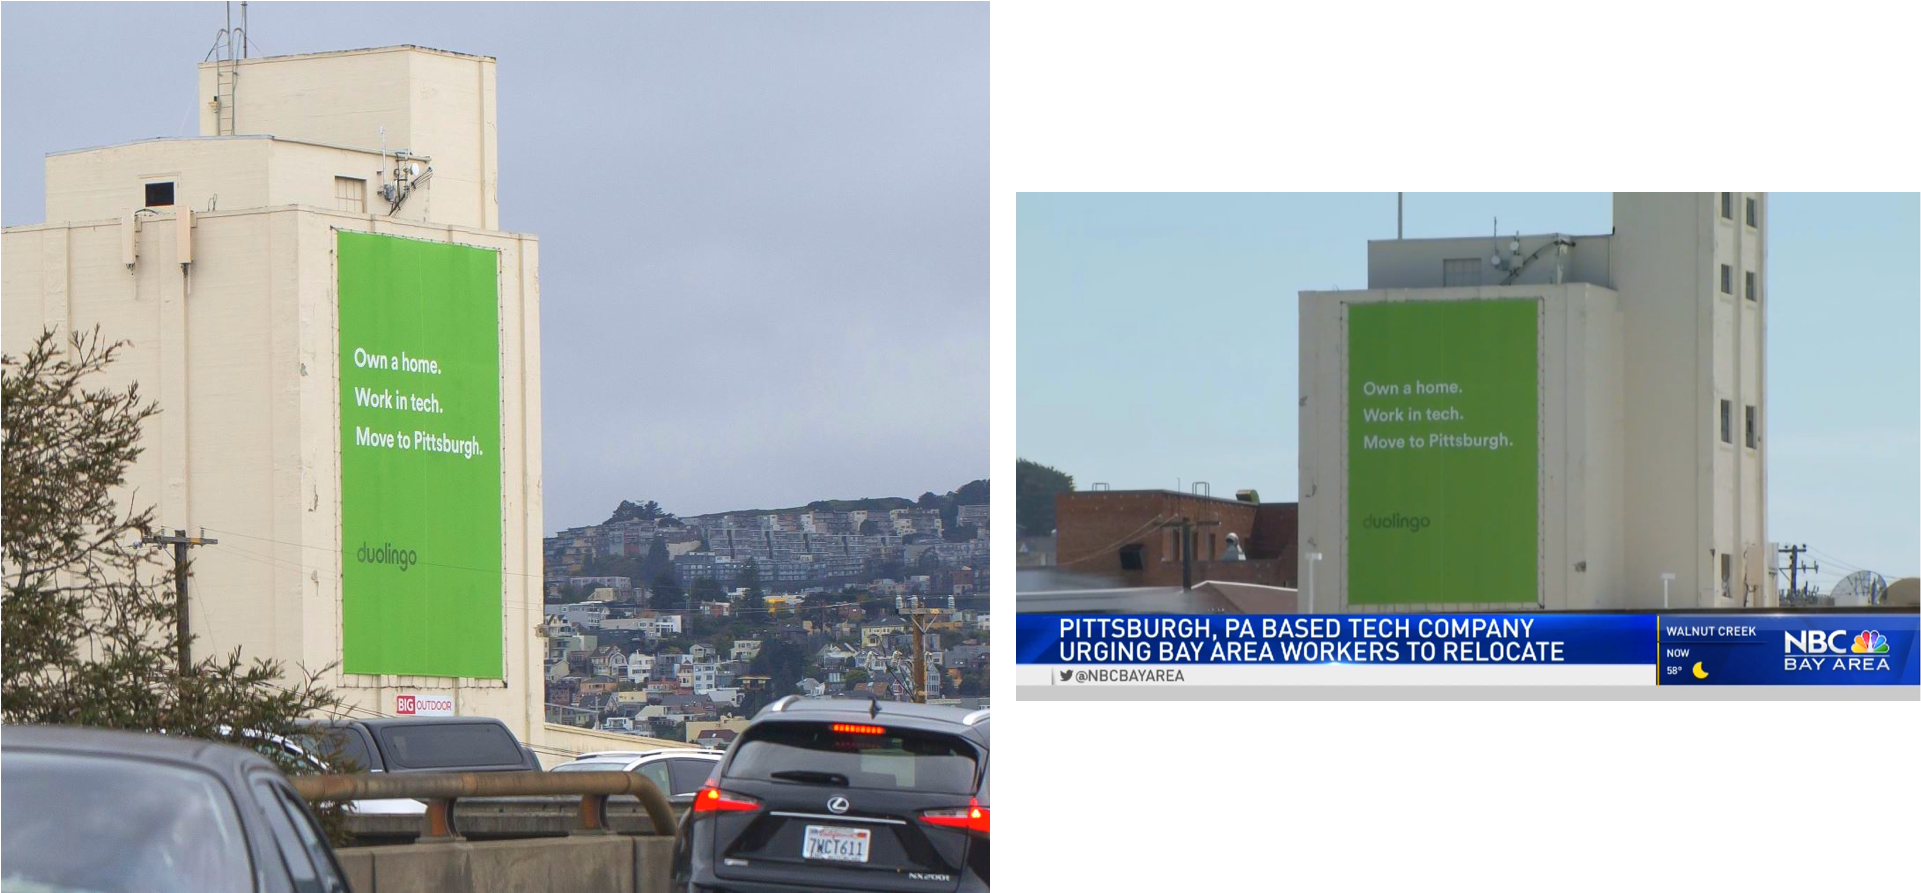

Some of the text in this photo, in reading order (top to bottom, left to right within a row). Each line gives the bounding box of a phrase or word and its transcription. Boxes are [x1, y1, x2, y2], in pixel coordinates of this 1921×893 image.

[354, 347, 441, 374] Own a home.
[1363, 380, 1462, 395] Own a home.
[355, 387, 443, 414] Work in tech.
[1363, 407, 1464, 422] Work in tech.
[356, 426, 483, 459] Move to Pittsburgh.
[1363, 432, 1513, 450] Move to Pittsburgh.
[1362, 513, 1431, 533] duolingo
[356, 541, 417, 571] duolingo
[398, 698, 452, 711] BIG OUTDOOR
[809, 837, 863, 856] 7WCT611
